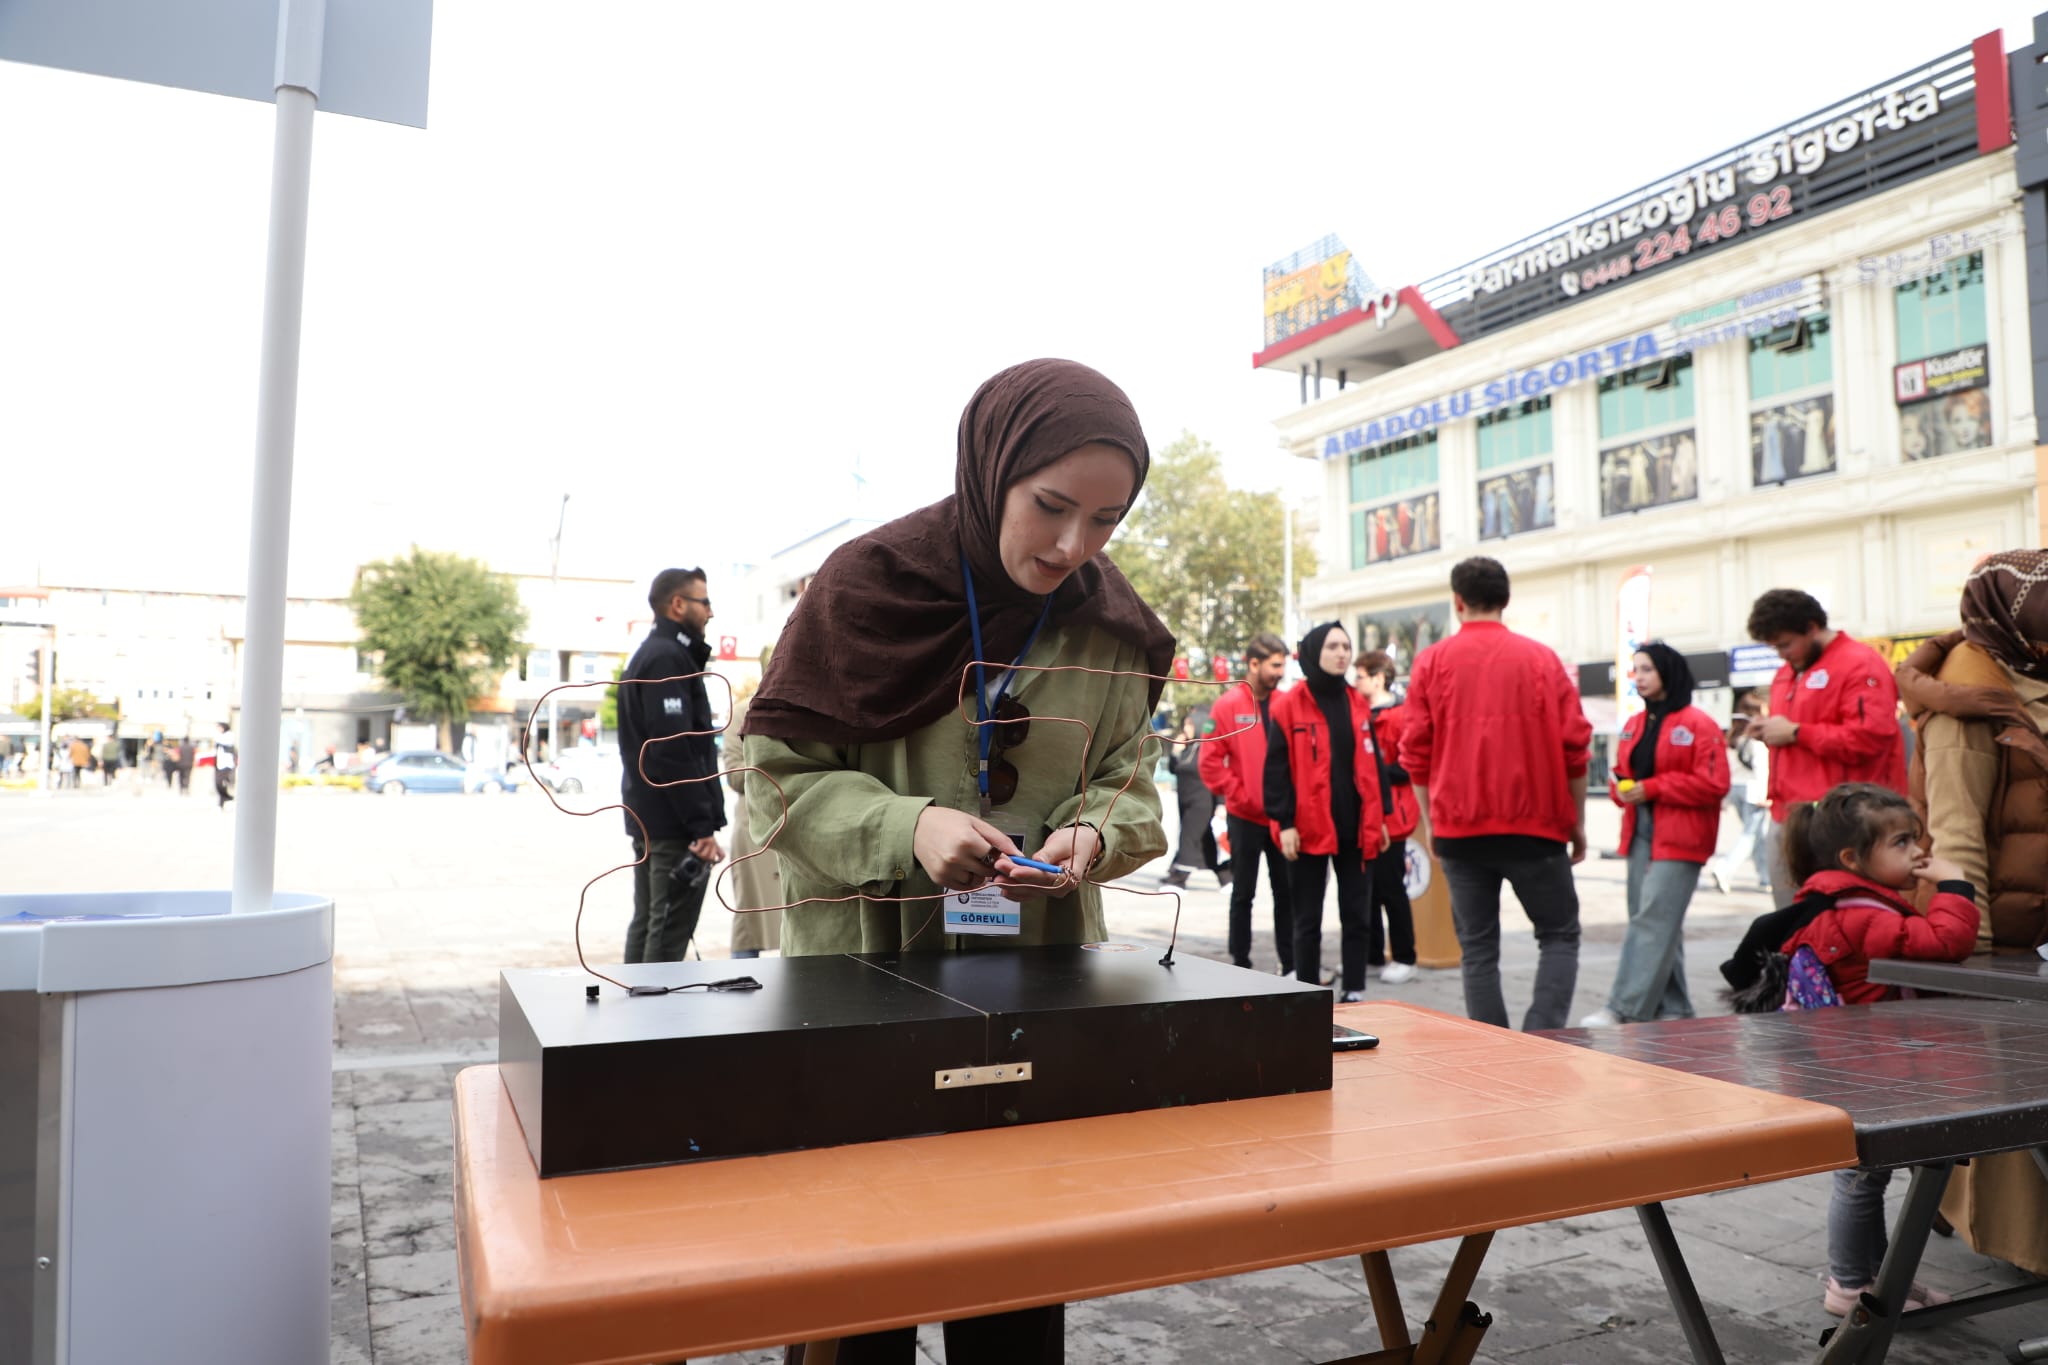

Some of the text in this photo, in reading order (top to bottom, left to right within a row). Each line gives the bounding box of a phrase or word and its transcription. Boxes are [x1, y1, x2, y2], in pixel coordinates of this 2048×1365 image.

[1635, 224, 1691, 270] 224
[1697, 204, 1741, 243] 46
[1746, 184, 1792, 226] 92
[1324, 392, 1471, 458] ANADOLU
[1483, 332, 1660, 408] SİGORTA
[960, 912, 1005, 924] GÖREVLİ
